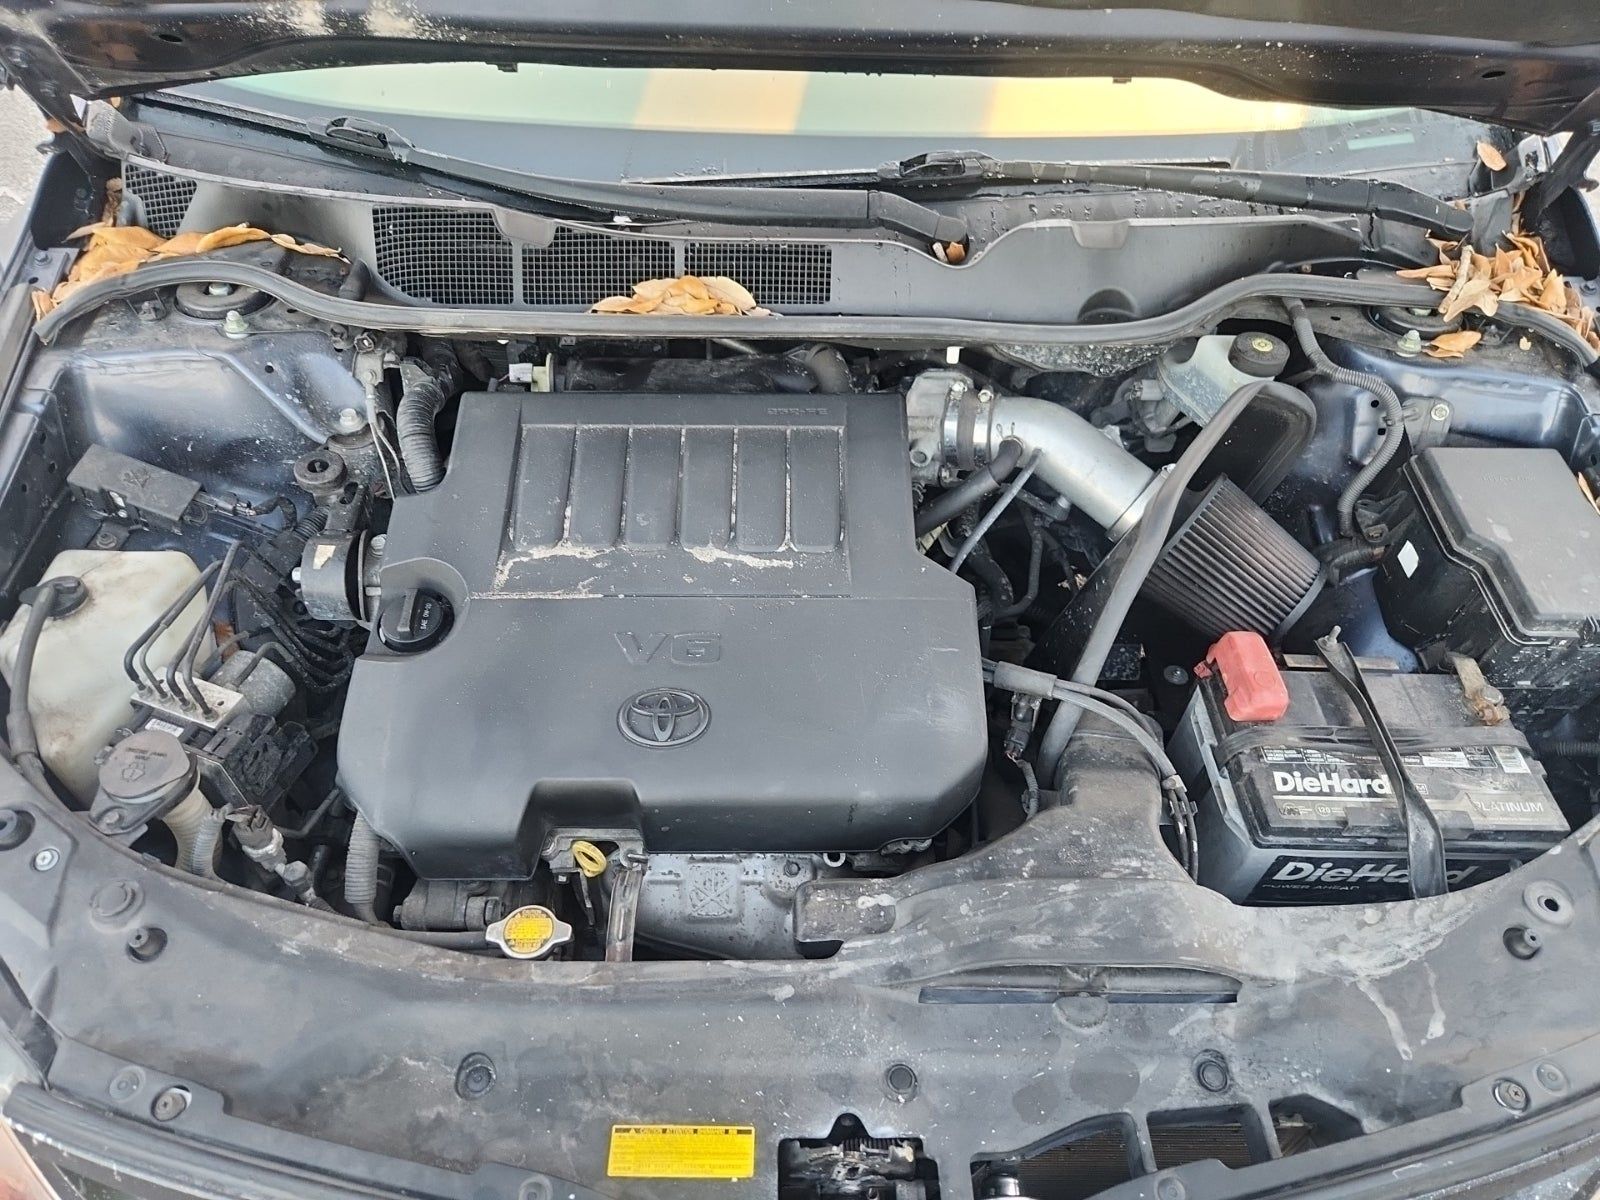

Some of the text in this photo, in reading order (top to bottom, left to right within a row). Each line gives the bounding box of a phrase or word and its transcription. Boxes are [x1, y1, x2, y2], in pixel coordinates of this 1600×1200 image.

[614, 631, 721, 666] V6
[1272, 771, 1392, 794] DieHard
[1474, 801, 1544, 812] PLATINUM
[1272, 861, 1479, 884] DieHad
